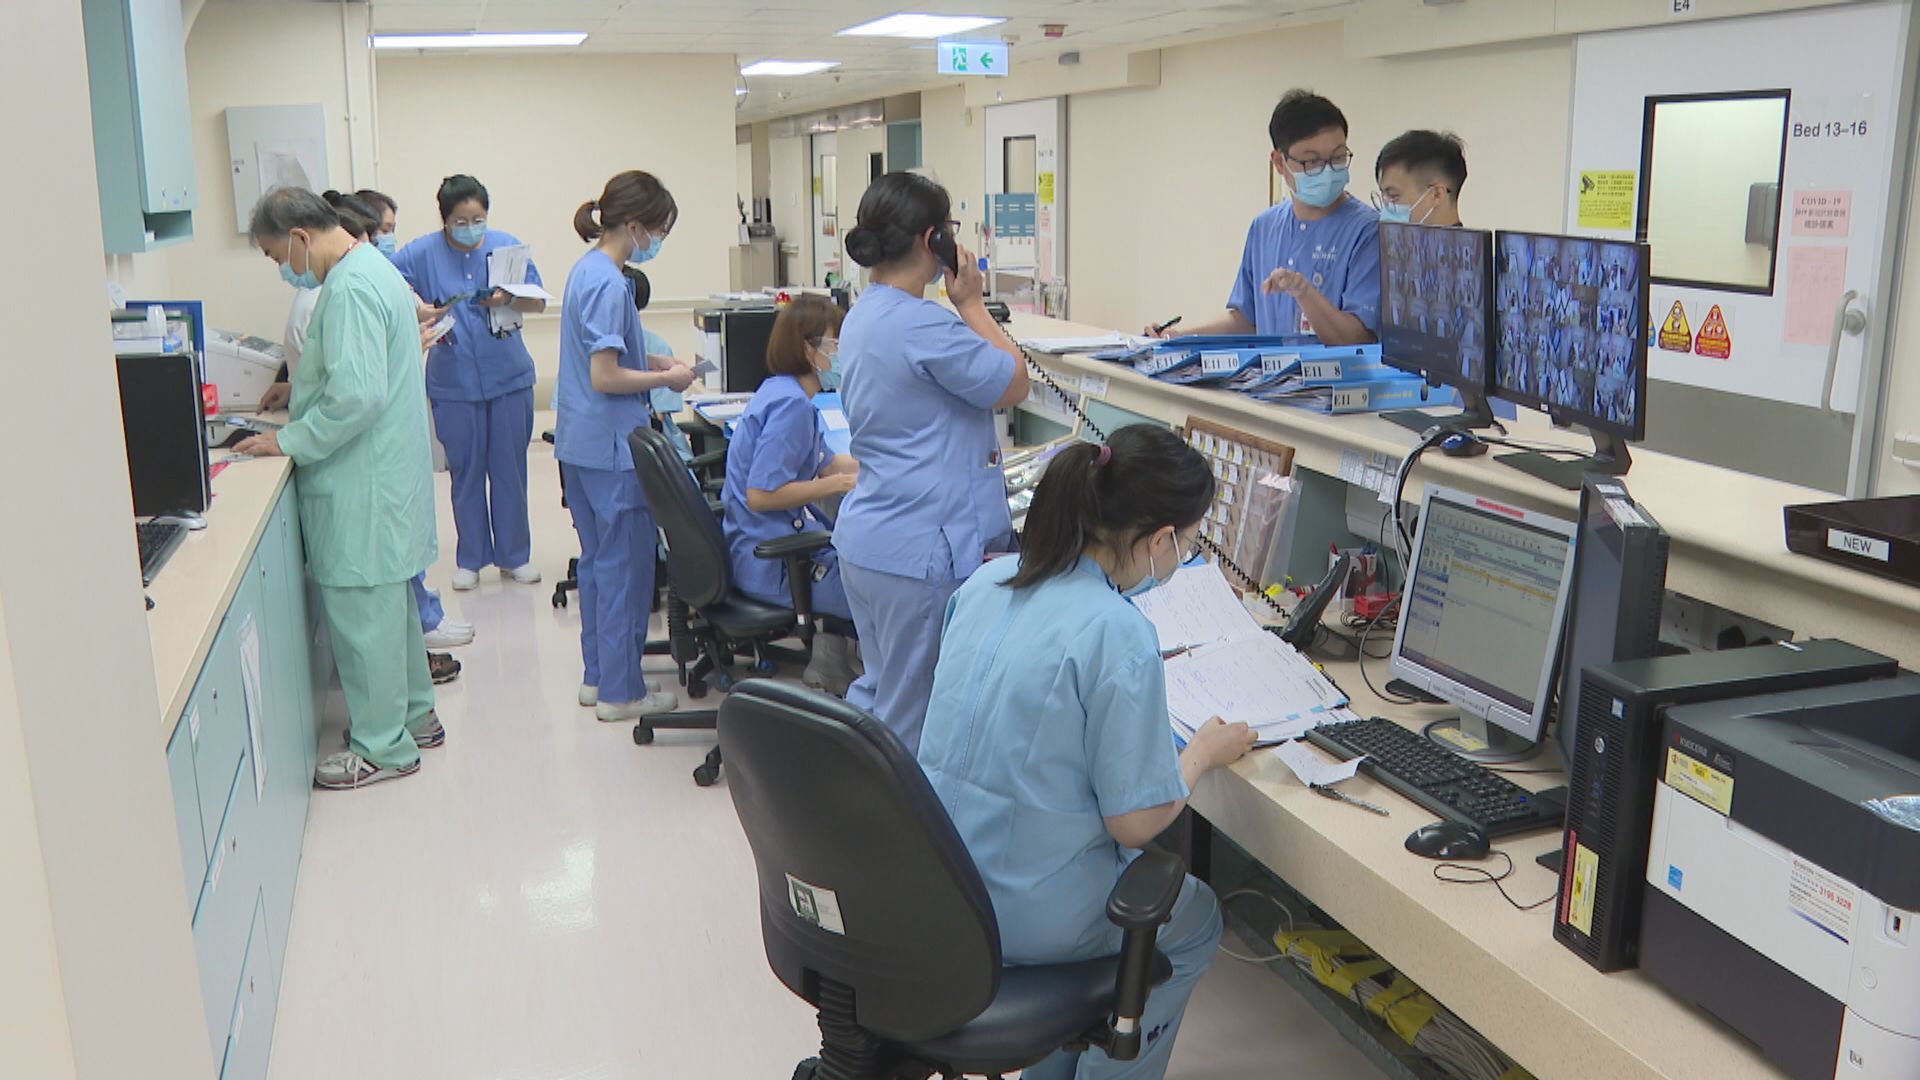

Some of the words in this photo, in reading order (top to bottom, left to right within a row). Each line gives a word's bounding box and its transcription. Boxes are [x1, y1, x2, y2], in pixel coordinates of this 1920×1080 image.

[1673, 0, 1690, 13] E4
[1793, 122, 1821, 137] Bed
[1801, 196, 1827, 206] COVID
[1203, 357, 1221, 370] E11
[1228, 357, 1238, 368] 10
[1263, 359, 1282, 372] E11
[1303, 366, 1322, 378] E11
[1334, 365, 1341, 377] 8
[1334, 394, 1350, 406] E11
[1361, 393, 1368, 403] 9
[1843, 535, 1872, 554] NEW
